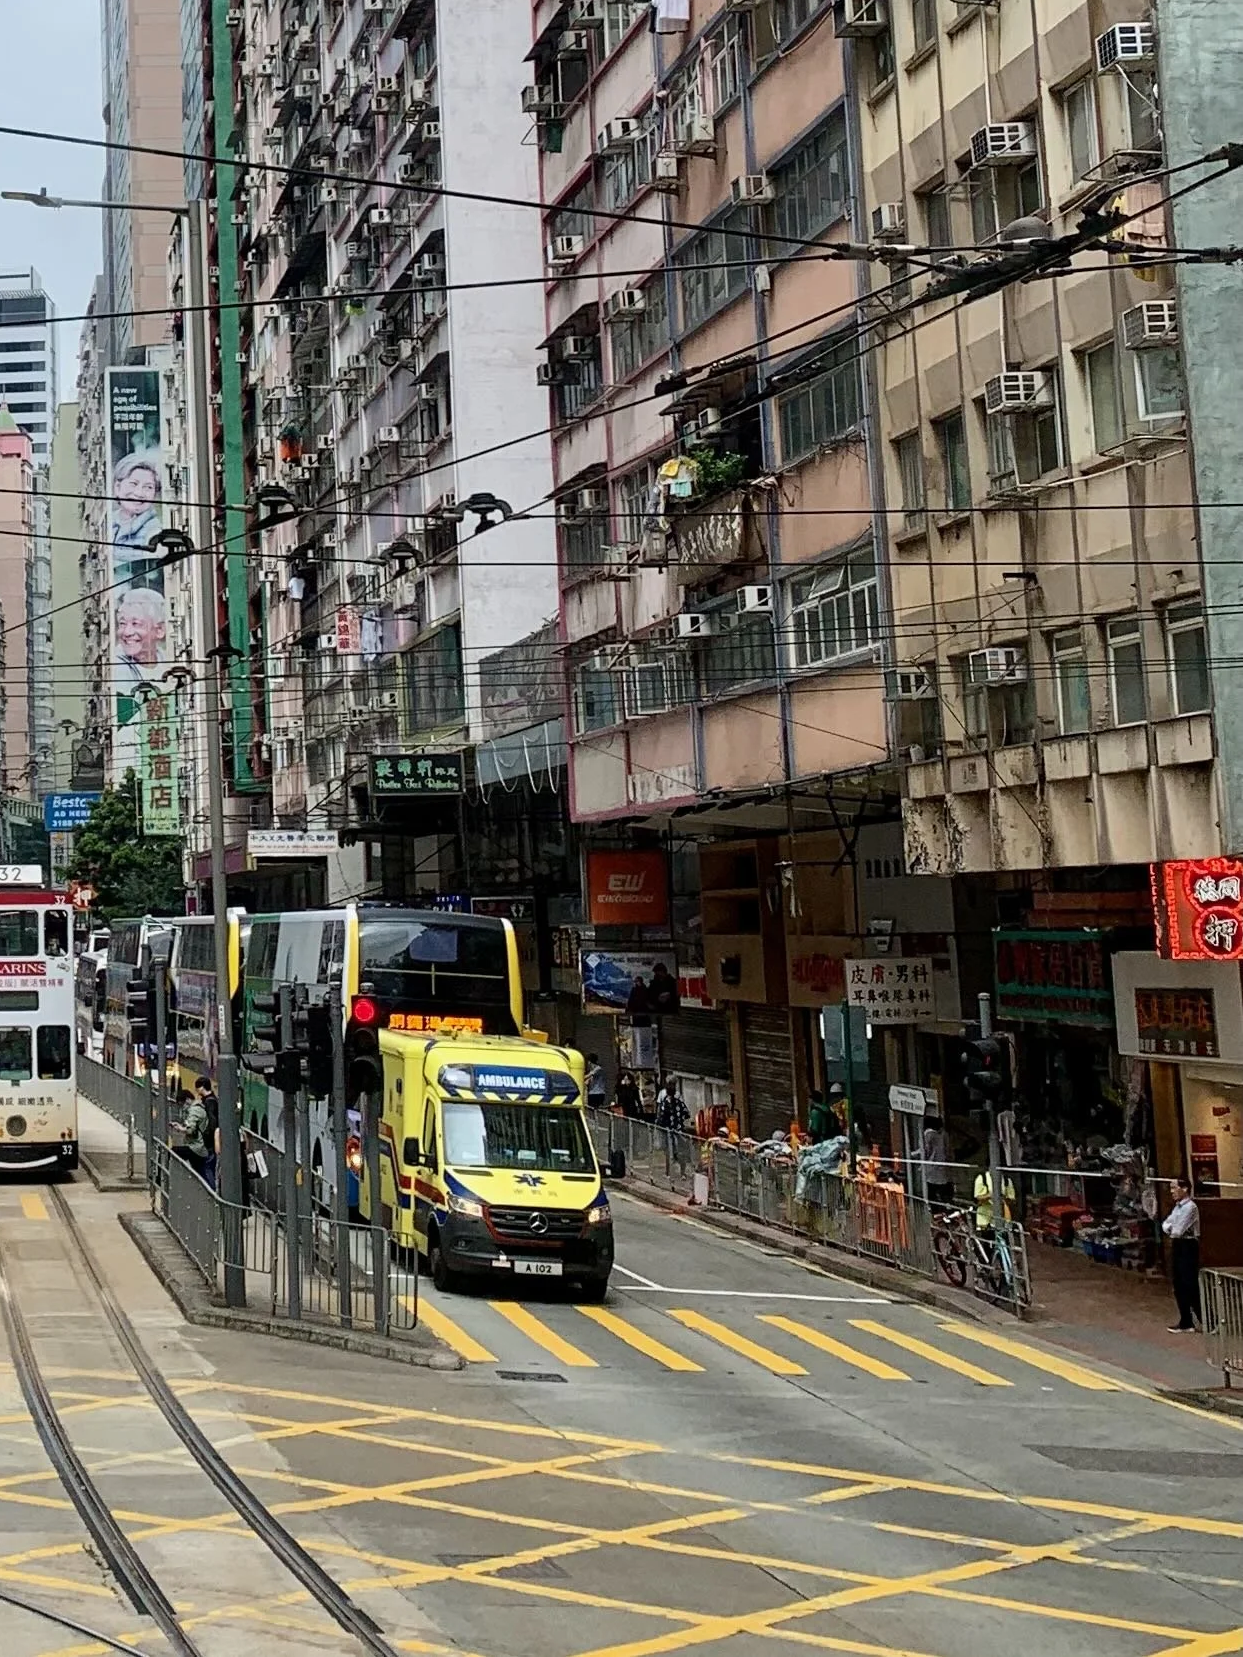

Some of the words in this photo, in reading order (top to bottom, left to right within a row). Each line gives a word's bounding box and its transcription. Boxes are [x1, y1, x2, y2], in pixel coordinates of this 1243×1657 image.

[146, 697, 172, 810] 新都酒店
[54, 895, 66, 905] 32
[1205, 914, 1238, 952] 押
[478, 1074, 546, 1089] AMBULANCE
[62, 1145, 74, 1155] 32
[525, 1263, 532, 1272] A
[535, 1264, 552, 1273] 102
